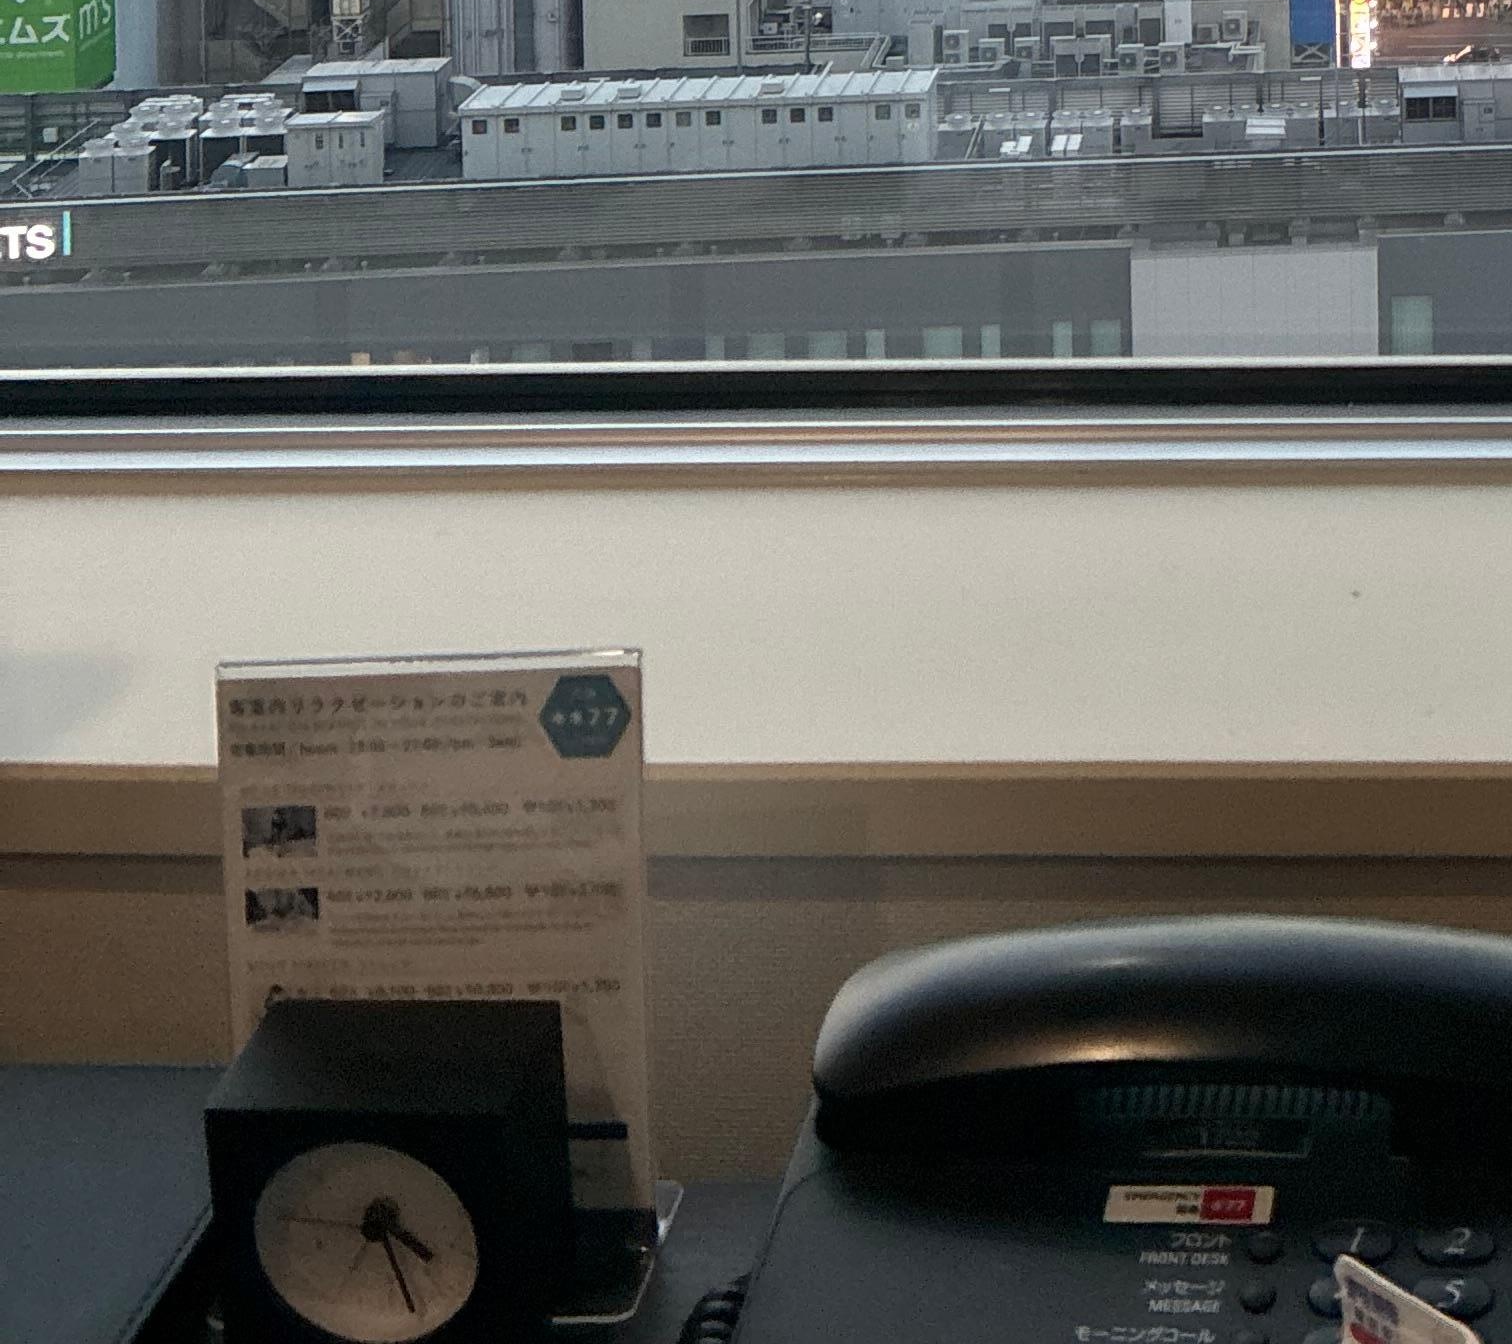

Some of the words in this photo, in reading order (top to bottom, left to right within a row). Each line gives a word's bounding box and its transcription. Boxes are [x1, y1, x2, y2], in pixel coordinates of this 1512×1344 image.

[1170, 1232, 1232, 1249] フロント
[1443, 1227, 1471, 1255] 2
[1437, 1279, 1465, 1308] 5
